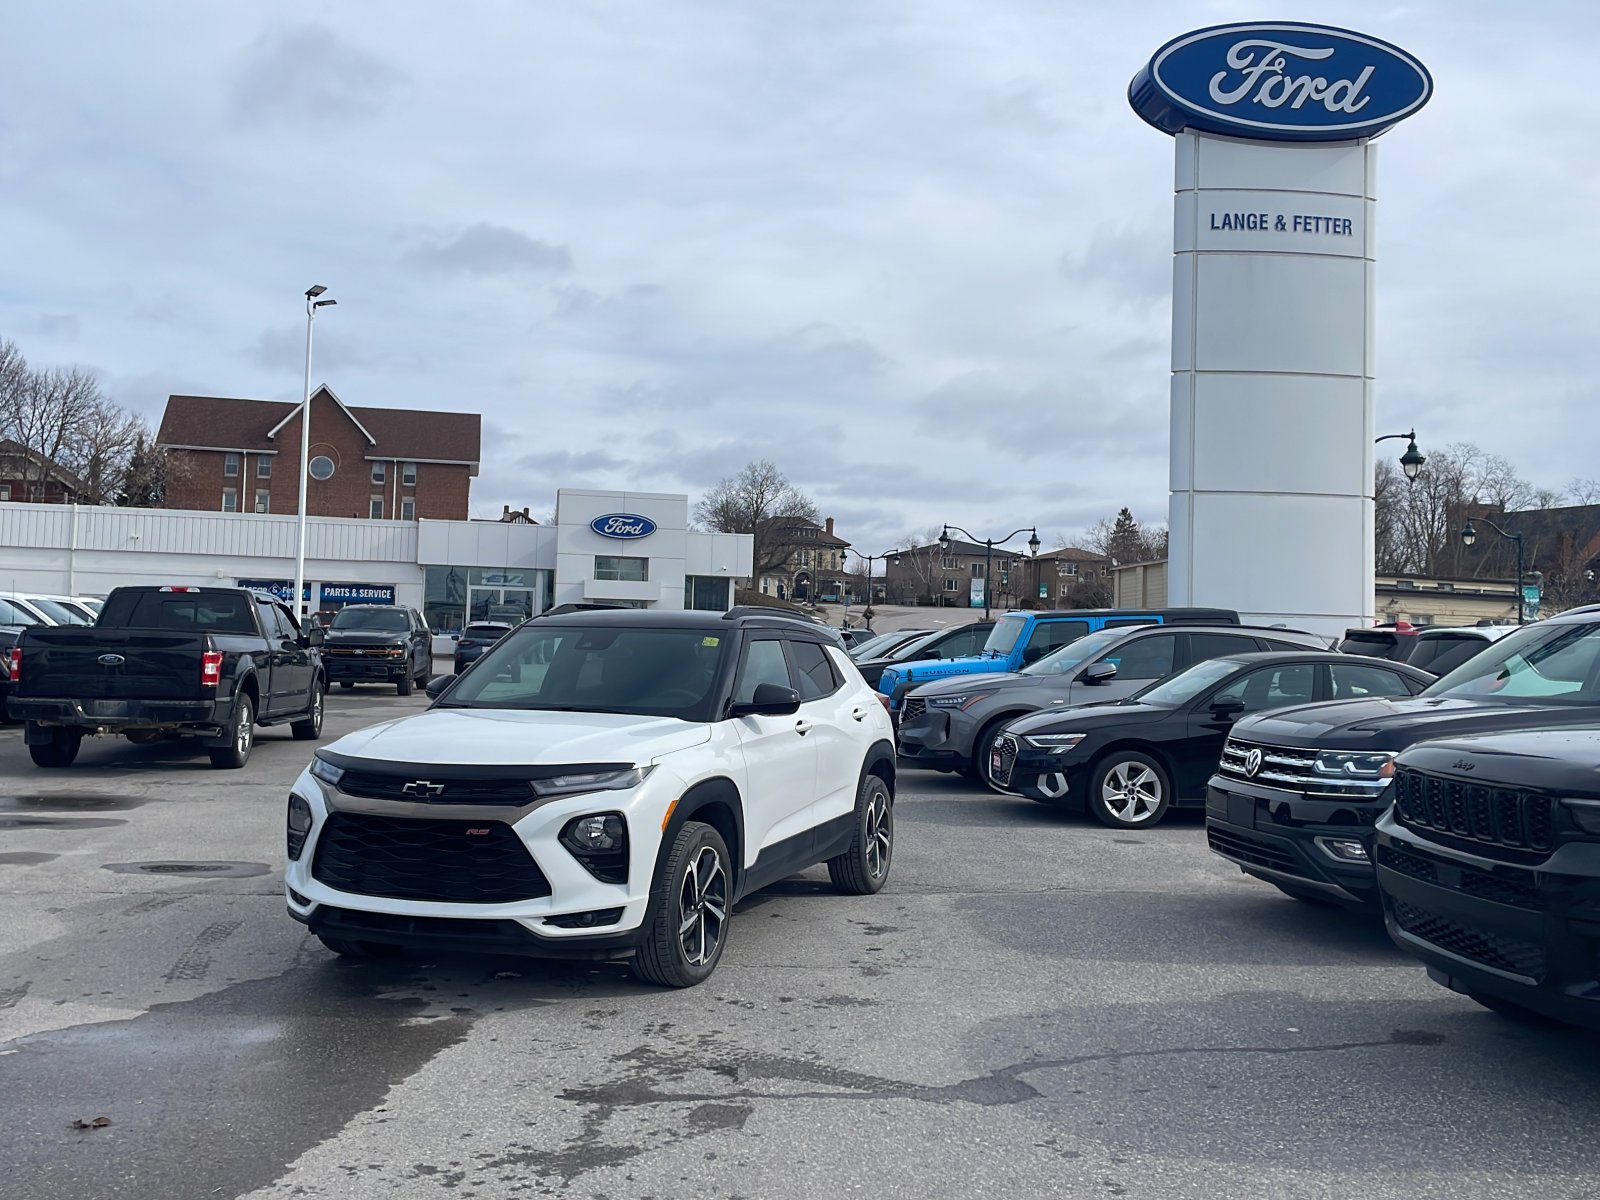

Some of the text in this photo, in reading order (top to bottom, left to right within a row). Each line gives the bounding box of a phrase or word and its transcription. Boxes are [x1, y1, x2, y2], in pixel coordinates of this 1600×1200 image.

[1209, 39, 1375, 113] Ford
[1210, 213, 1353, 236] LANGE & FETTER
[604, 517, 642, 534] Ford
[324, 587, 392, 598] PARTS & SERVICE
